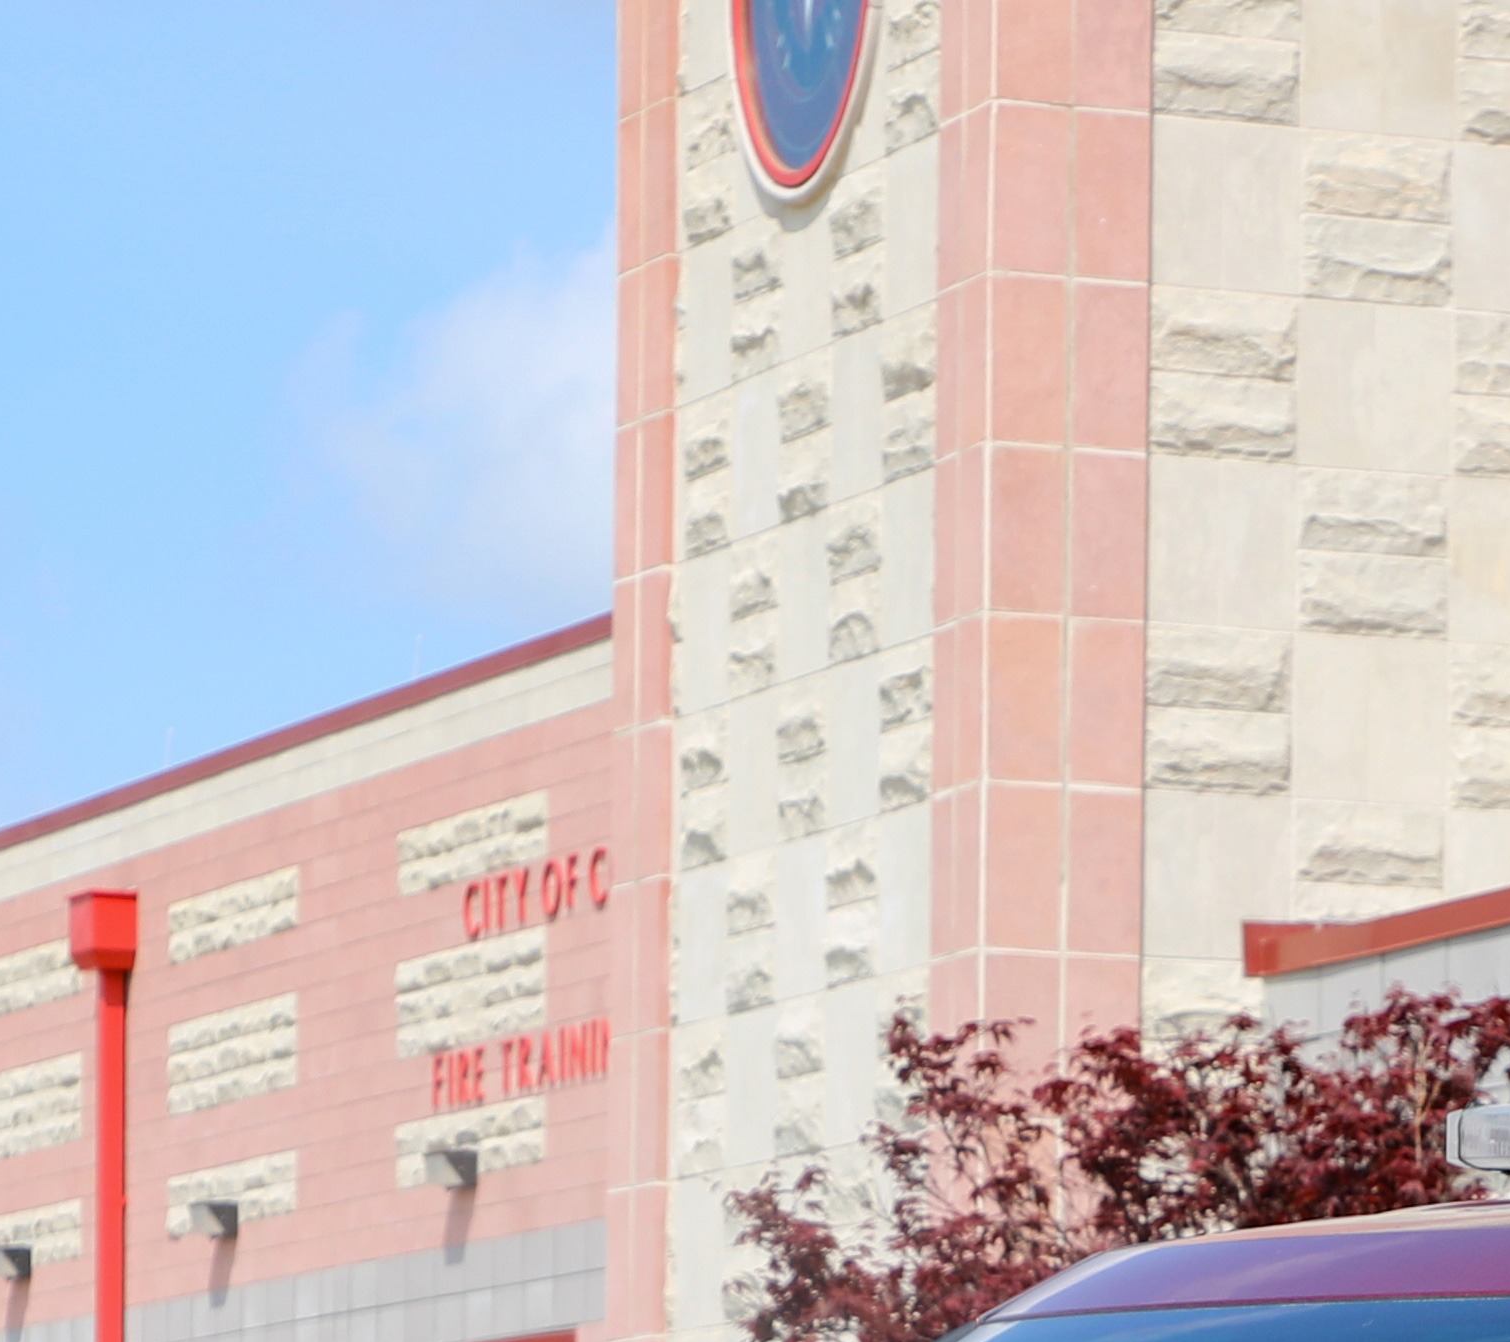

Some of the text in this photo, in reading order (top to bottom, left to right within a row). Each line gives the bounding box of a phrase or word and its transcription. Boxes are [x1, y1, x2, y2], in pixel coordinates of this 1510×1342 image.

[462, 867, 530, 941] CITY
[542, 852, 579, 923] OF
[431, 1044, 486, 1112] FIRE
